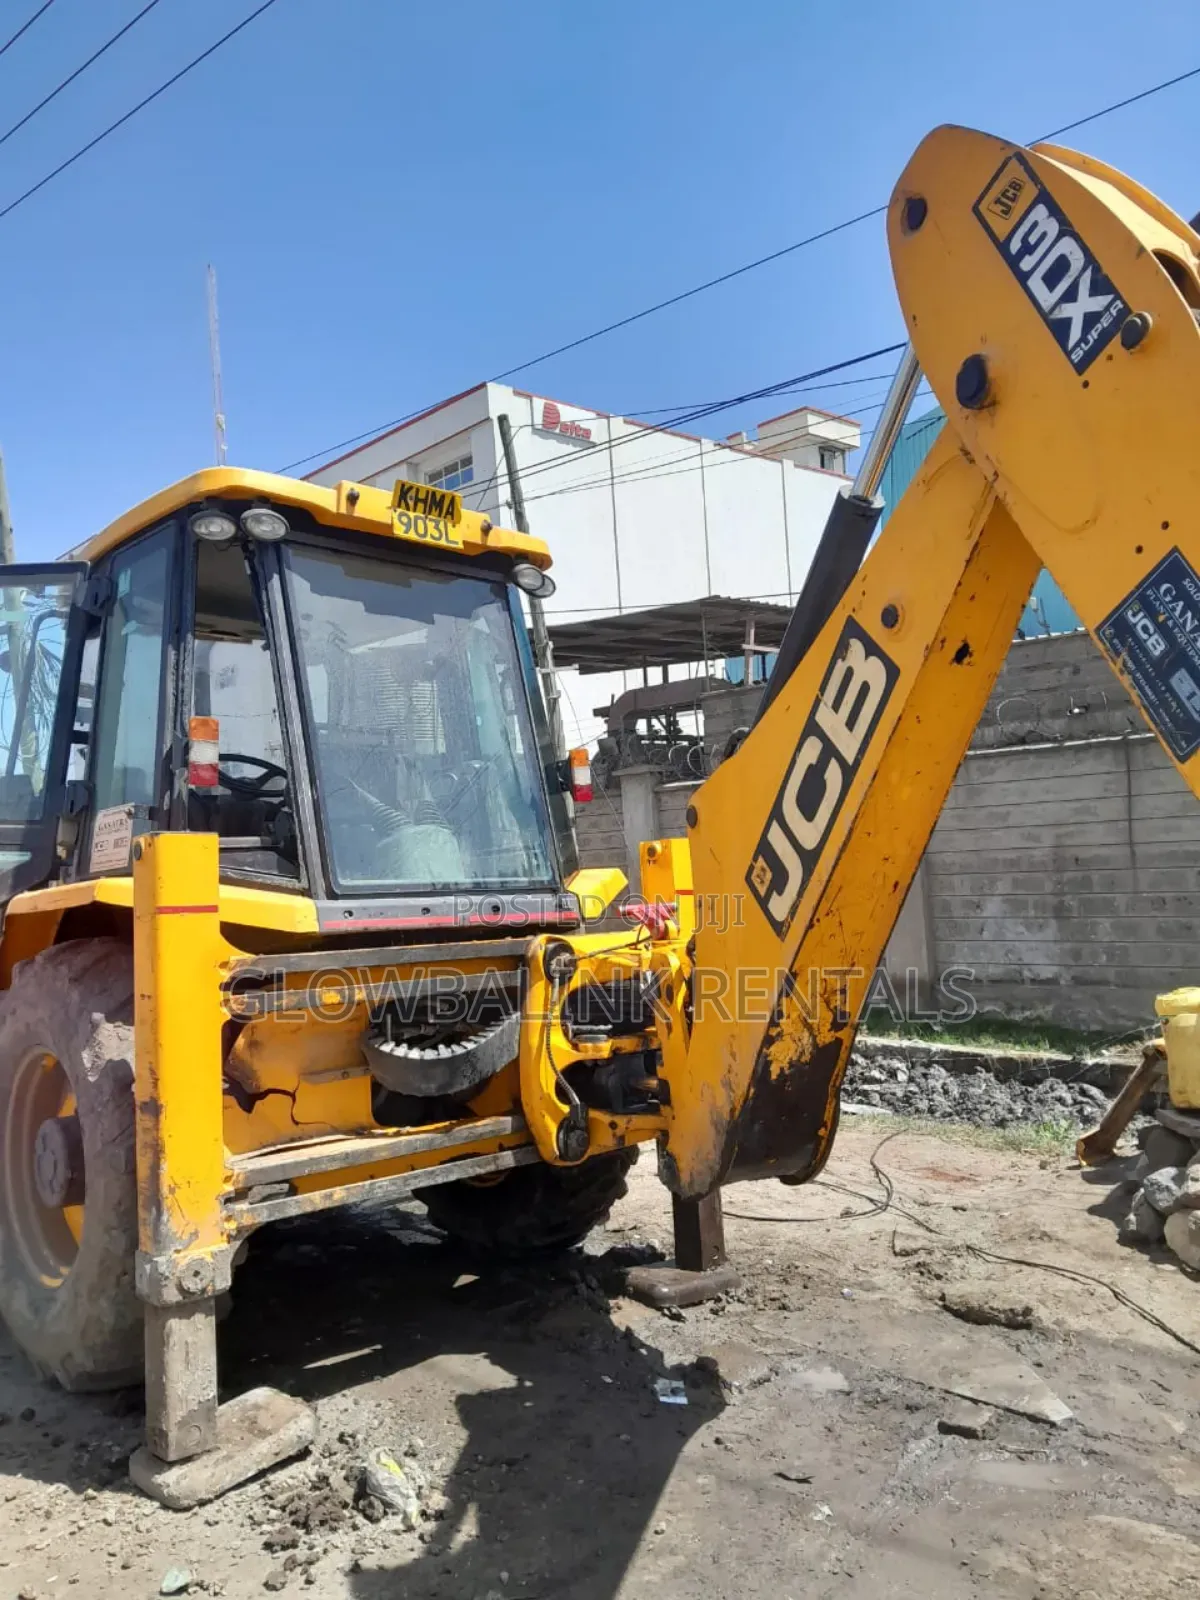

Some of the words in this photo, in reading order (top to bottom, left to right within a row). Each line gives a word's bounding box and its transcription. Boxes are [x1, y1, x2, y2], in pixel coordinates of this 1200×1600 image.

[994, 179, 1023, 216] JCB
[1009, 203, 1115, 351] 3DX
[1071, 300, 1124, 363] SUPER
[397, 482, 455, 520] KHMA
[397, 511, 459, 545] 903L
[1128, 610, 1165, 656] JCB
[767, 638, 887, 922] JCB
